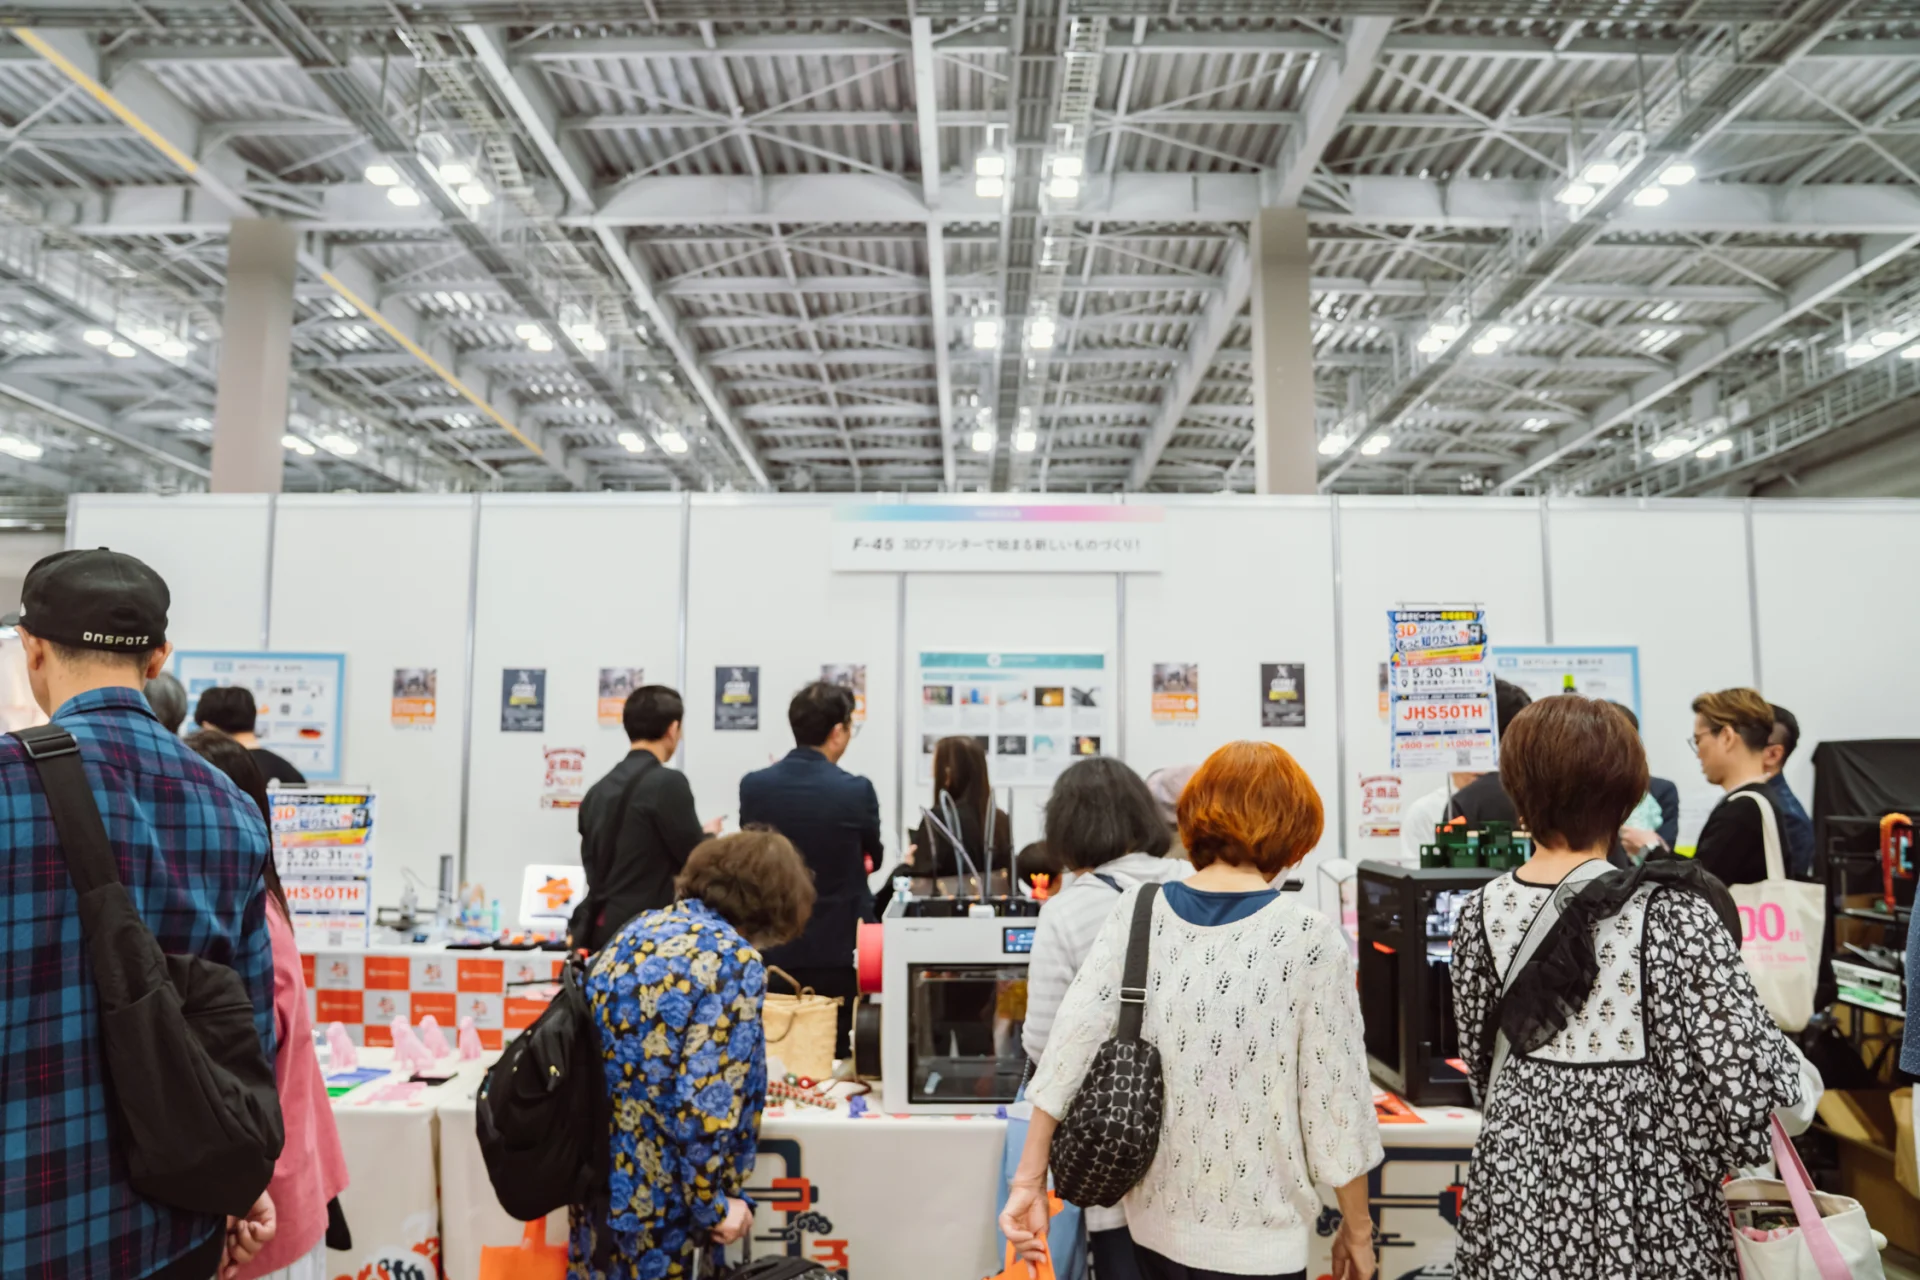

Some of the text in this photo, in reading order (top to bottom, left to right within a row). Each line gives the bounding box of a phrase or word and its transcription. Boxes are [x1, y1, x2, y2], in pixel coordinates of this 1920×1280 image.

[852, 537, 894, 551] F-45
[1403, 704, 1483, 720] JHS50TH
[285, 886, 359, 899] HS50TH
